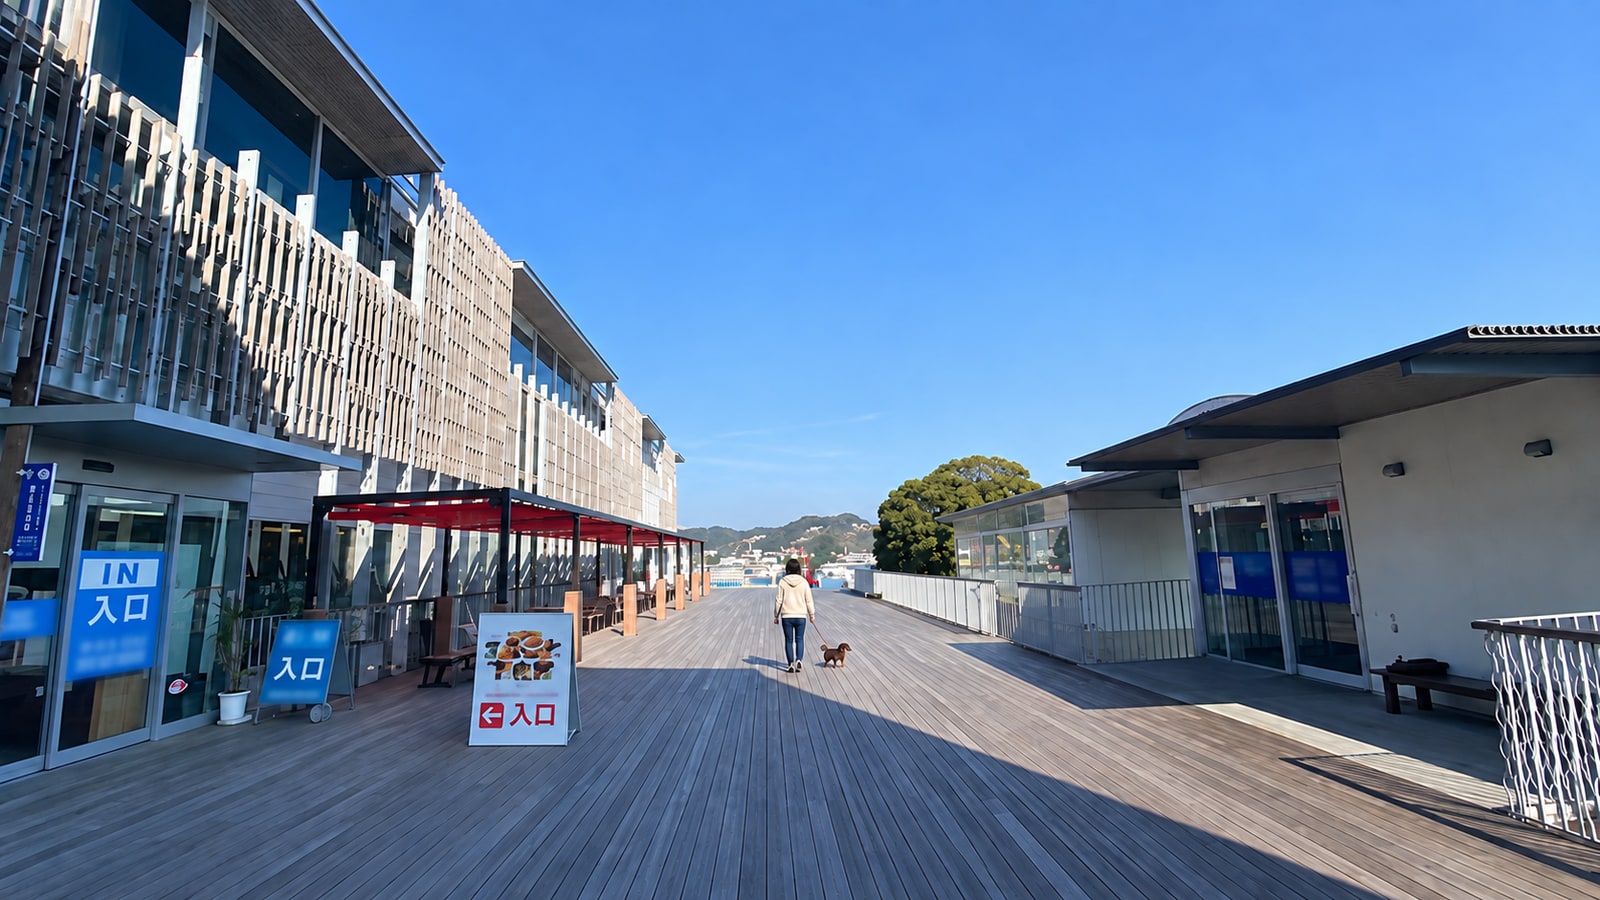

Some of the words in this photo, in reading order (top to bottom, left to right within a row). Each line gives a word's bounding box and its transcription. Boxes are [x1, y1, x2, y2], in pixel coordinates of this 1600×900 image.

[102, 563, 139, 584] IN
[88, 594, 149, 626] 入口
[273, 656, 325, 681] 入口
[509, 702, 555, 726] 入口
